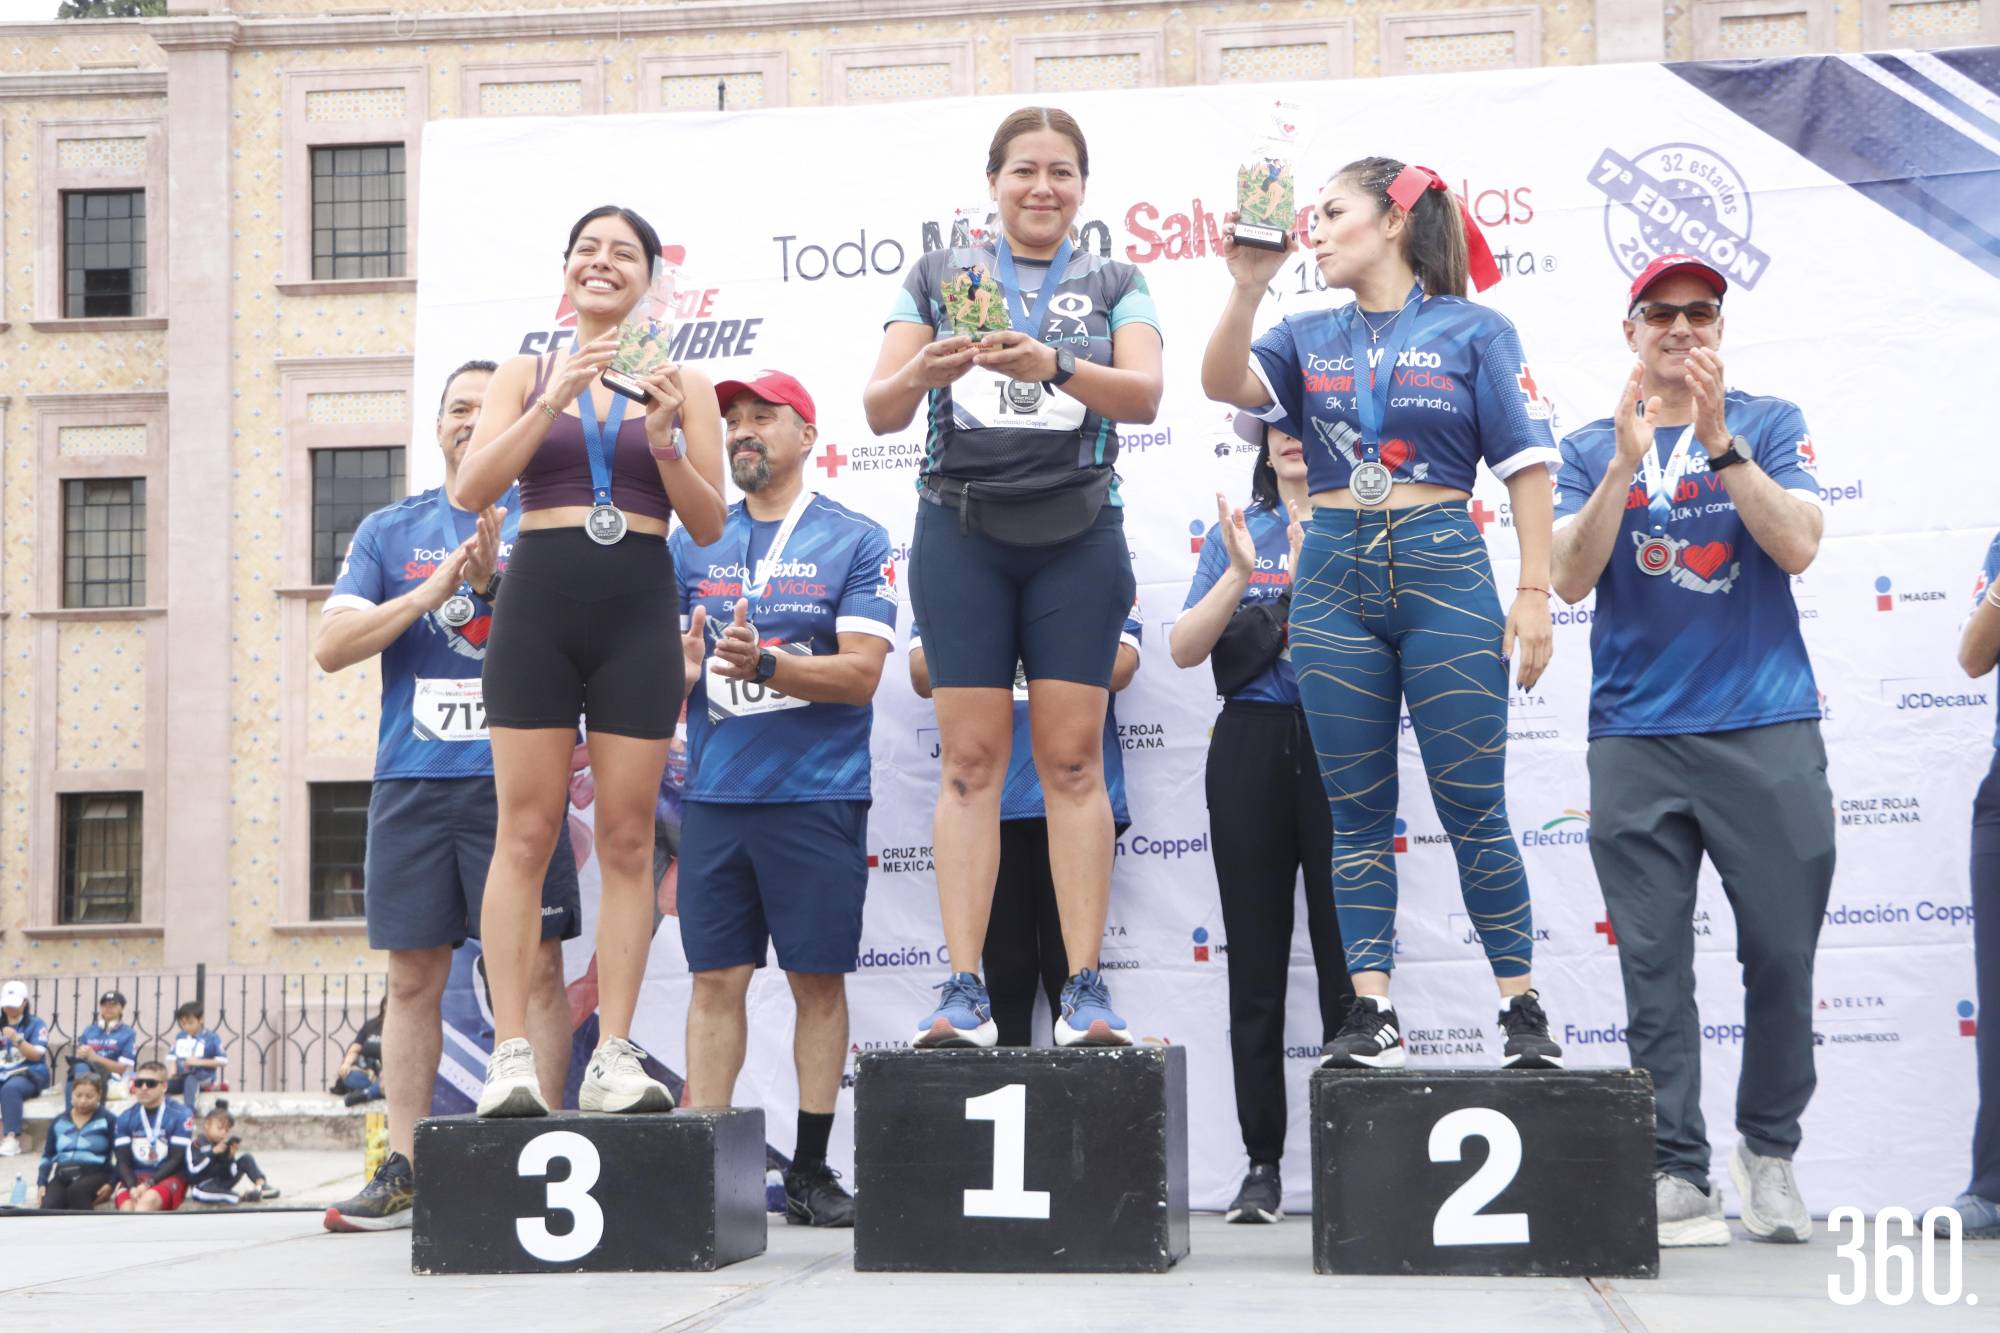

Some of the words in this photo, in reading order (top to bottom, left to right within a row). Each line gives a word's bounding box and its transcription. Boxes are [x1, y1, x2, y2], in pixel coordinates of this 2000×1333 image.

[1661, 153, 1684, 173] 32
[1688, 159, 1738, 216] estados
[1631, 183, 1762, 284] EDICIÓN
[773, 229, 905, 283] Todo
[1394, 371, 1455, 392] Vidas
[1118, 427, 1171, 453] oppel
[852, 446, 886, 458] CRUZ
[888, 444, 922, 456] ROJA
[852, 457, 921, 472] MEXICANA
[777, 580, 829, 597] Vidas
[1899, 592, 1947, 603] IMAGEN
[1509, 695, 1546, 707] ELTA
[1897, 692, 1988, 710] JCDecaux
[1130, 723, 1165, 736] ROJA
[1840, 799, 1878, 812] CRUZ
[1882, 797, 1920, 810] ROJA
[1841, 813, 1921, 826] MEXICANA
[883, 848, 918, 860] CRUZ
[1131, 833, 1209, 860] Coppel
[883, 861, 936, 873] MEXICA
[1833, 997, 1885, 1009] DELTA
[1408, 1030, 1445, 1042] CRUZ
[1448, 1027, 1484, 1040] ROJA
[1409, 1043, 1486, 1056] MEXICANA
[964, 1083, 1051, 1220] 1
[1428, 1107, 1530, 1247] 2
[516, 1130, 604, 1263] 3
